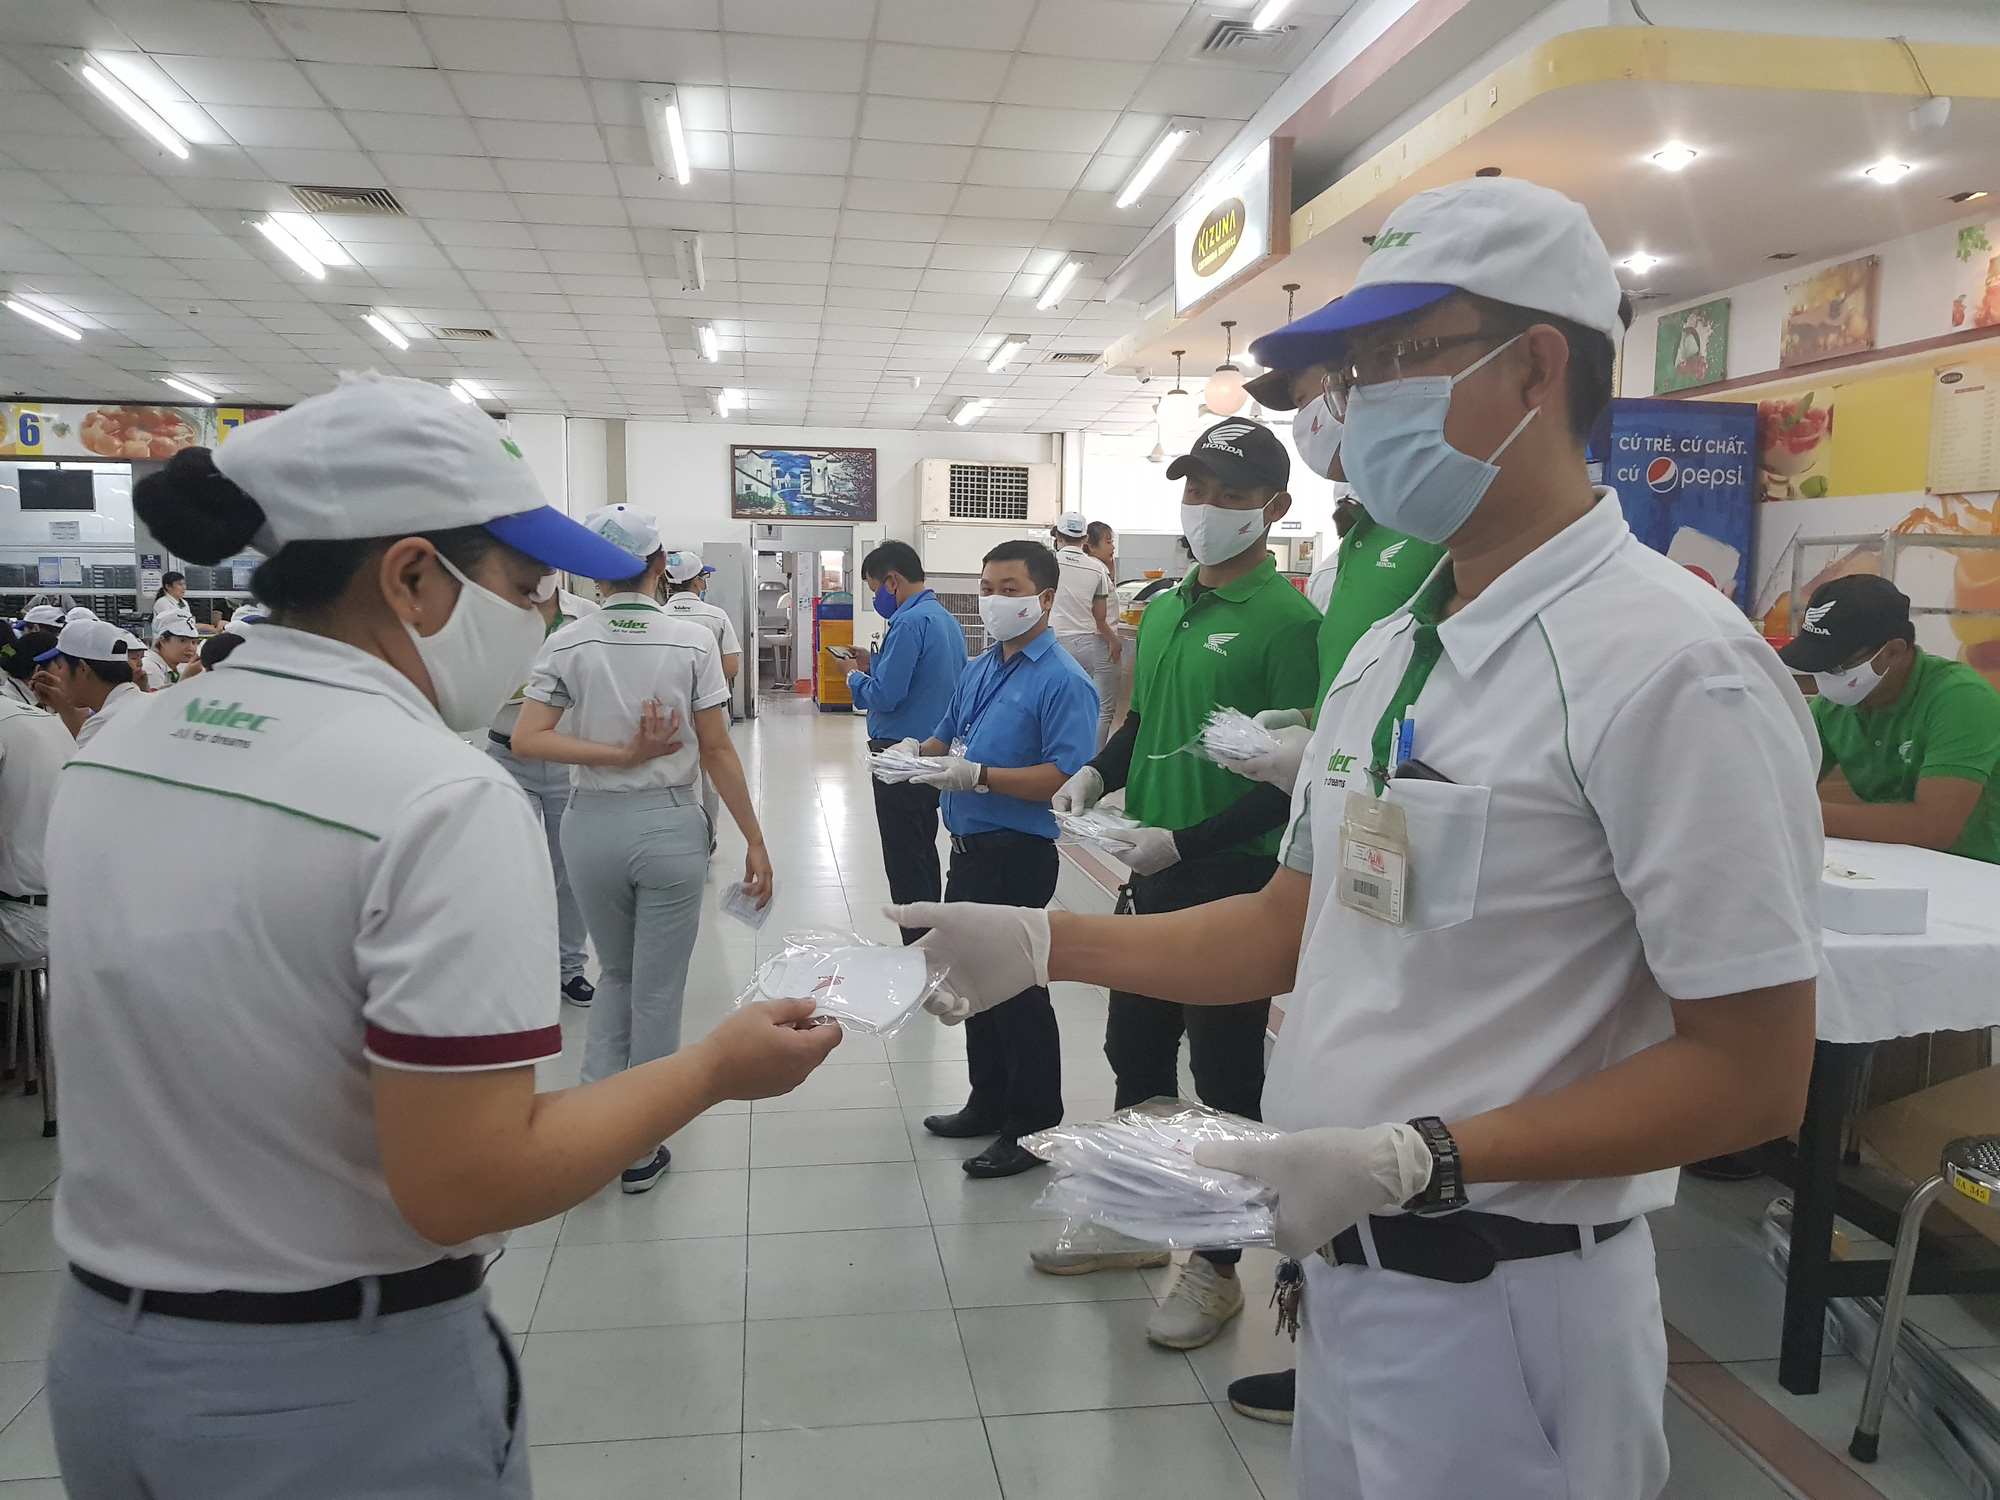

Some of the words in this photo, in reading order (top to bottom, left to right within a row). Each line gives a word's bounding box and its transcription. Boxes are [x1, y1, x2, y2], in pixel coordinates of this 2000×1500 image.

[1198, 208, 1237, 257] KIZUNA
[1370, 226, 1421, 255] dec
[19, 413, 42, 447] 6
[1201, 442, 1244, 458] HONDA
[1618, 432, 1642, 451] CỨ
[1644, 434, 1676, 453] TRẺ.
[1680, 435, 1703, 453] CỨ
[1705, 434, 1747, 455] CHẤT.
[1617, 464, 1641, 482] CỨ
[1681, 465, 1743, 490] pepsi
[608, 619, 650, 629] Nidec
[1801, 622, 1831, 636] ONDA
[1202, 642, 1227, 657] HONDA
[183, 697, 281, 733] Nidec
[1327, 748, 1358, 773] dec
